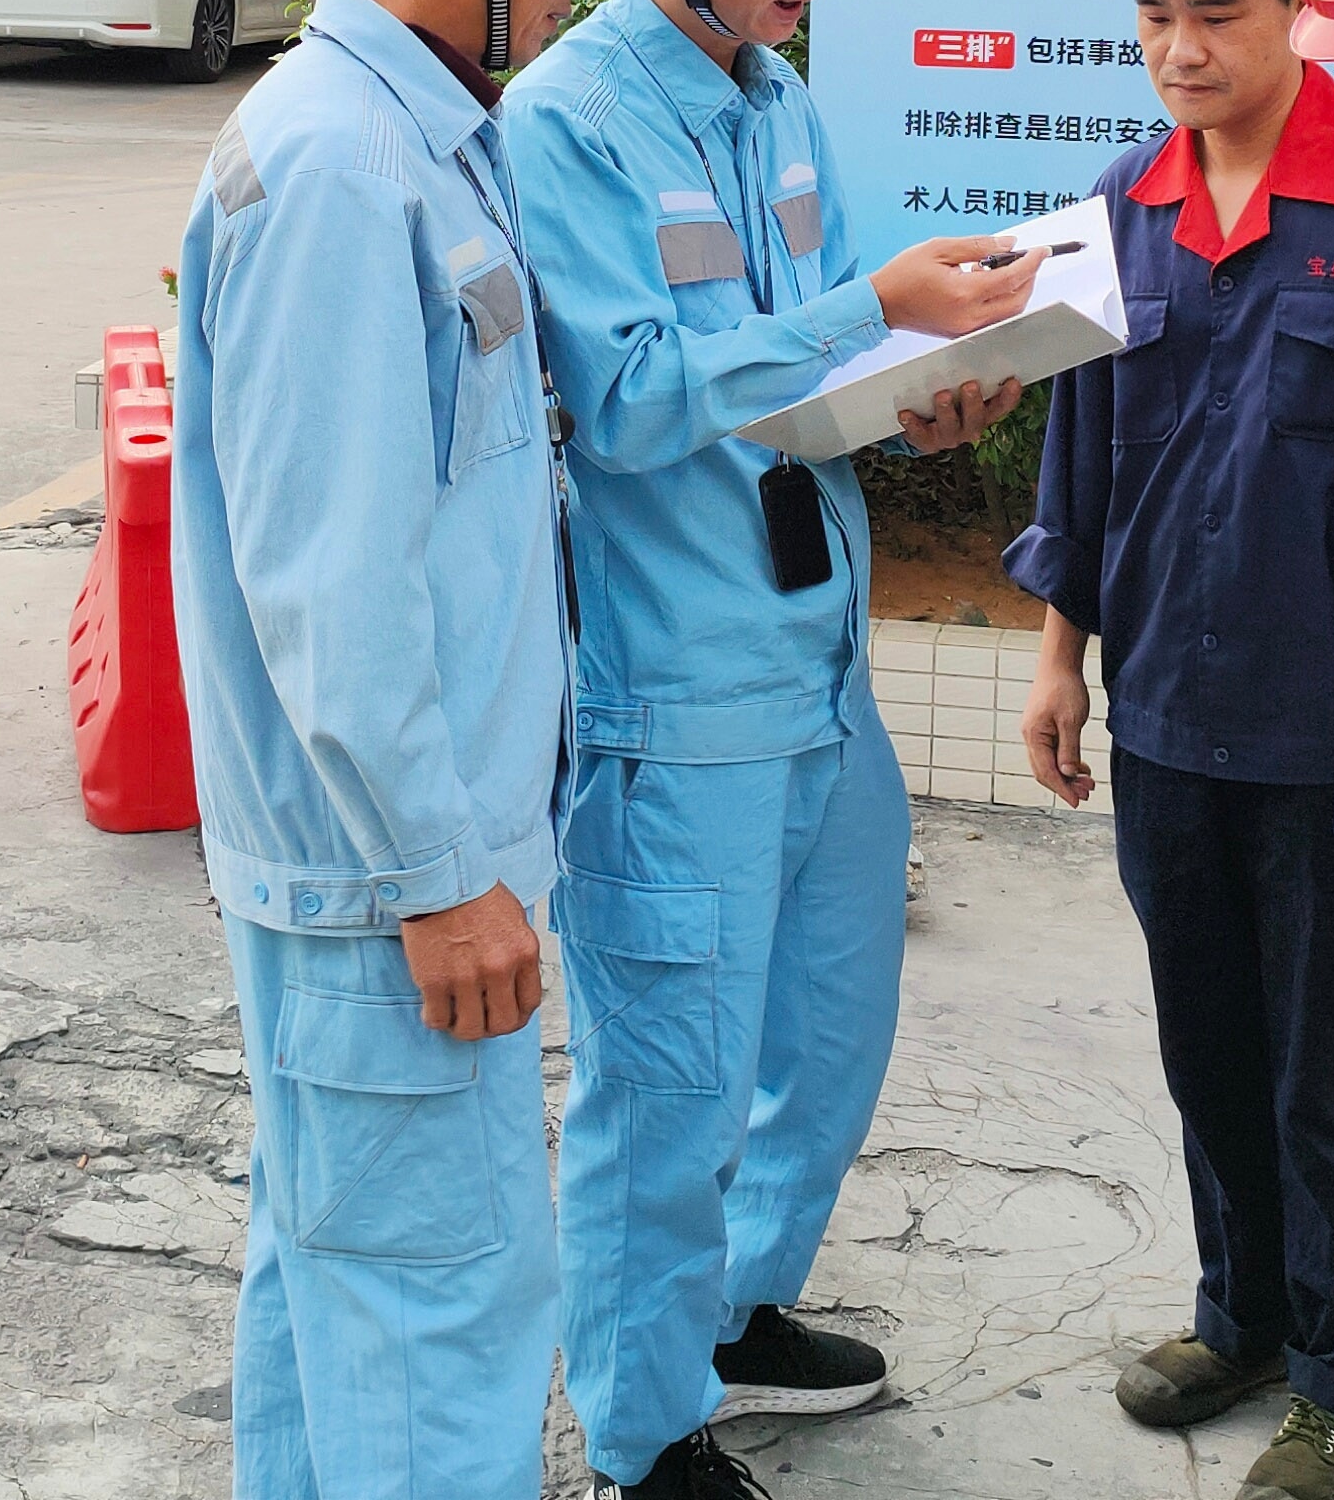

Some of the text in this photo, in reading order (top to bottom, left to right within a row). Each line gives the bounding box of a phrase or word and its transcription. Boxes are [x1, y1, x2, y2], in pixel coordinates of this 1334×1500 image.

[1026, 36, 1146, 67] 包括事故
[903, 185, 1092, 217] 术人员和其他
